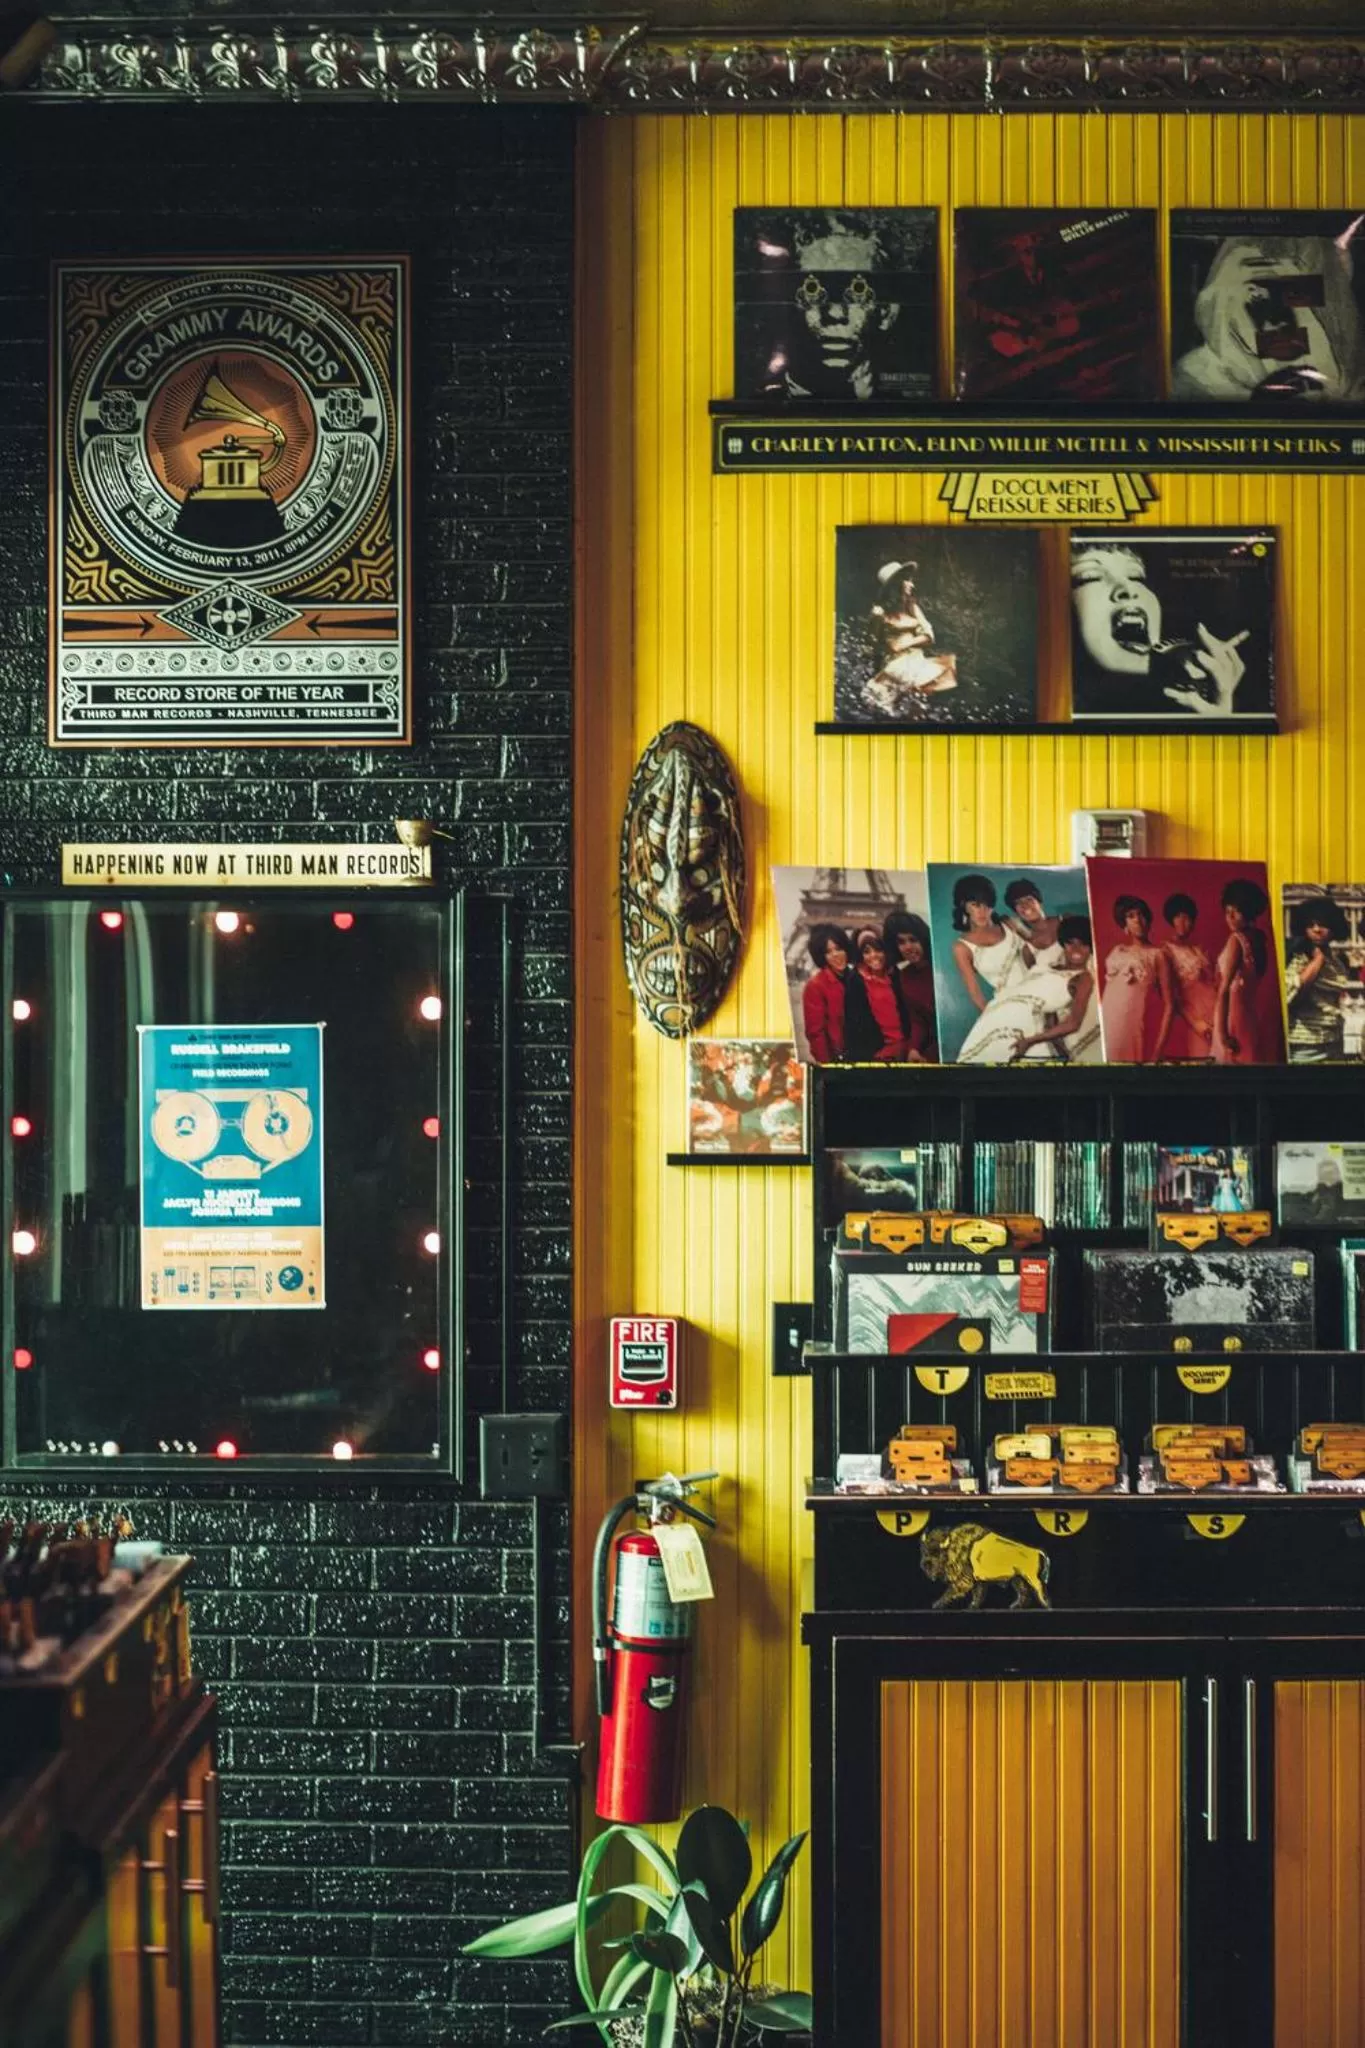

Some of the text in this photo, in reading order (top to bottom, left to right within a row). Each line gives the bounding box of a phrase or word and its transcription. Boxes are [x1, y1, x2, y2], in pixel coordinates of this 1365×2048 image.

[221, 284, 291, 301] ANNUAL
[123, 308, 340, 382] GRAMMY AWARDS
[751, 437, 839, 452] CHARLEY
[842, 437, 923, 453] PATTON,
[927, 438, 985, 452] BLIND
[988, 438, 1051, 452] WILLIE
[1136, 440, 1149, 452] &
[1158, 438, 1269, 453] MISSISSIPPI
[1273, 438, 1342, 454] SHEIKS
[992, 479, 1100, 495] DOCUMENT
[976, 497, 1117, 514] REISSUE SERIES
[125, 509, 169, 553] SUNDAY,
[167, 543, 232, 568] FEBRUARY
[235, 554, 253, 568] 13,
[115, 686, 344, 701] RECORD STORE OF THE YEAR
[80, 708, 378, 720] THIRD MAN RECORDS NASHVILLE, TENNESSEE
[73, 853, 421, 876] HAPPENING NOW AT THIRD MAN RECORDS
[906, 1261, 932, 1273] SUN
[619, 1322, 669, 1342] FIRE
[935, 1369, 949, 1391] T
[895, 1513, 912, 1533] P
[1054, 1512, 1071, 1531] R
[1208, 1516, 1225, 1534] S
